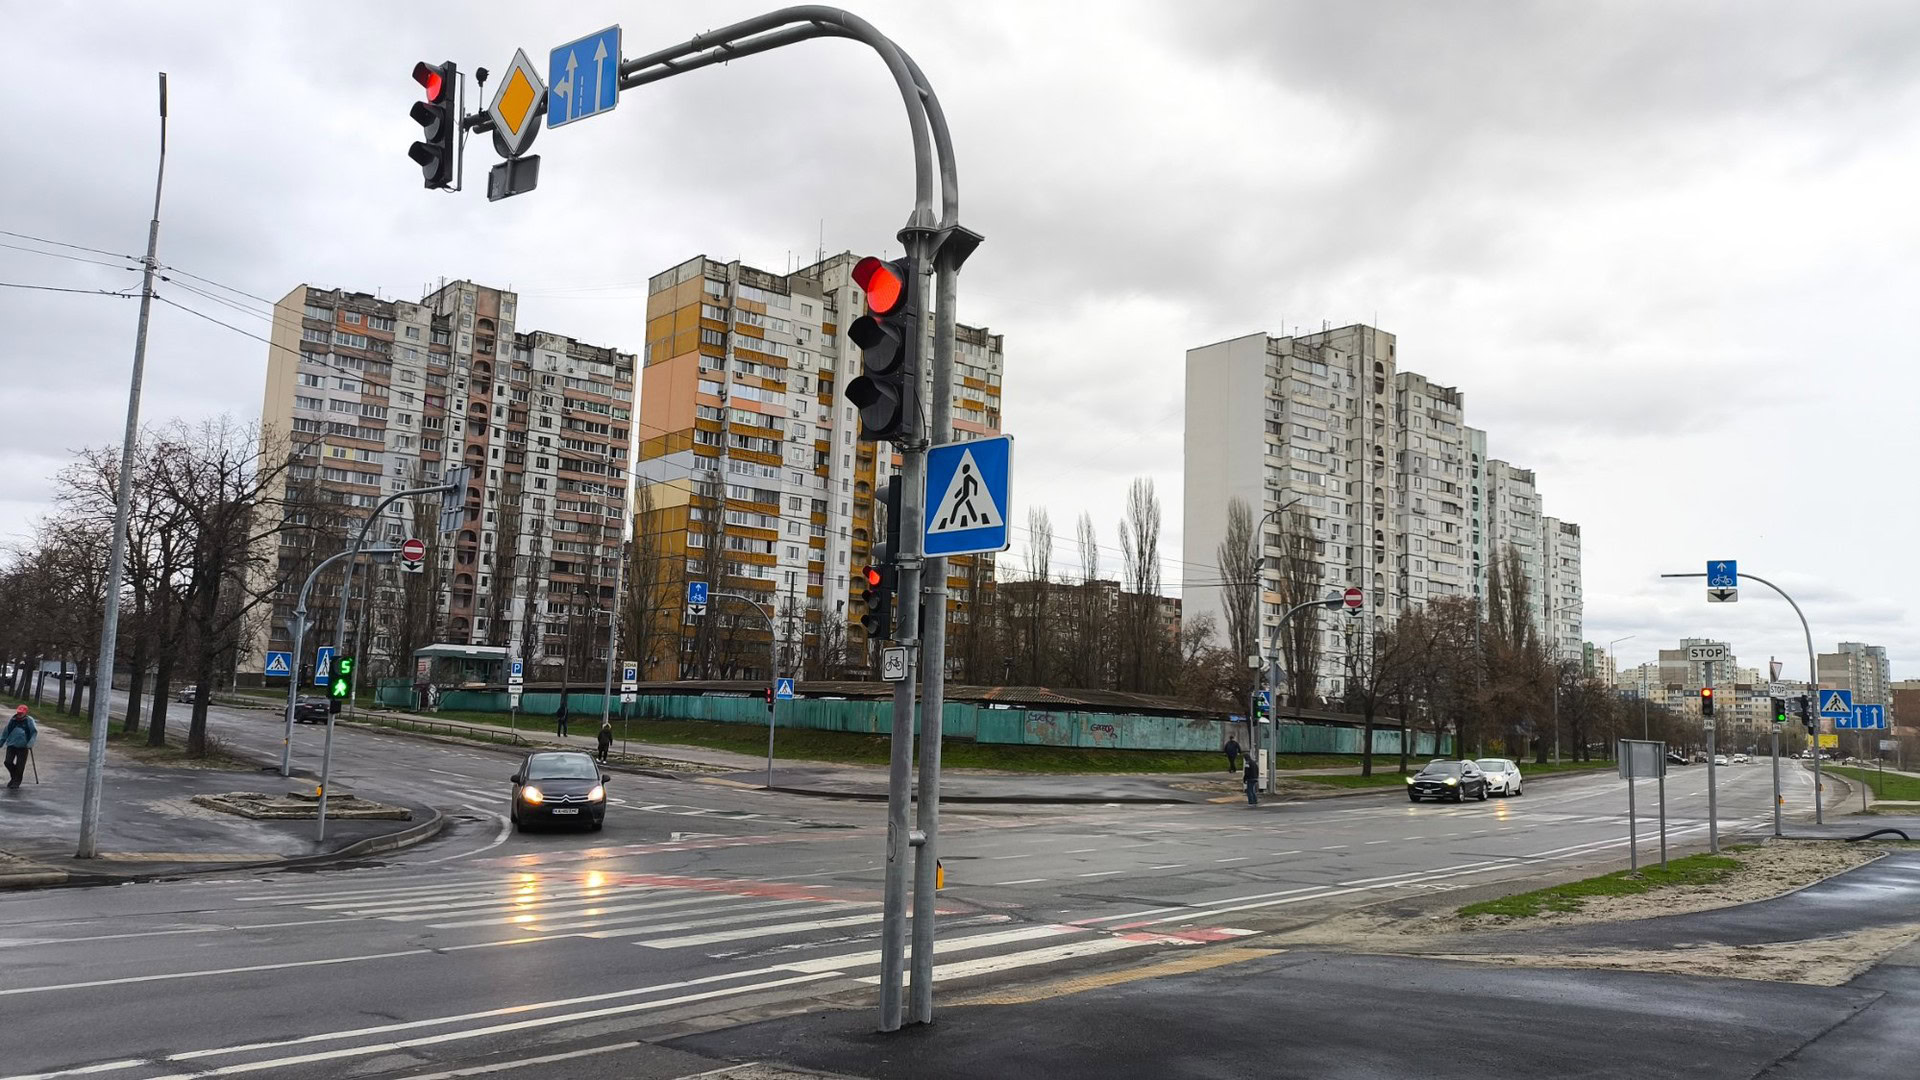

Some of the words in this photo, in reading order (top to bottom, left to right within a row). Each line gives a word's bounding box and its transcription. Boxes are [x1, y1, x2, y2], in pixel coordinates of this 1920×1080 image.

[1691, 648, 1723, 658] STOP
[341, 660, 350, 673] 5
[514, 663, 520, 673] P
[627, 669, 634, 679] P
[1770, 685, 1785, 694] STOP
